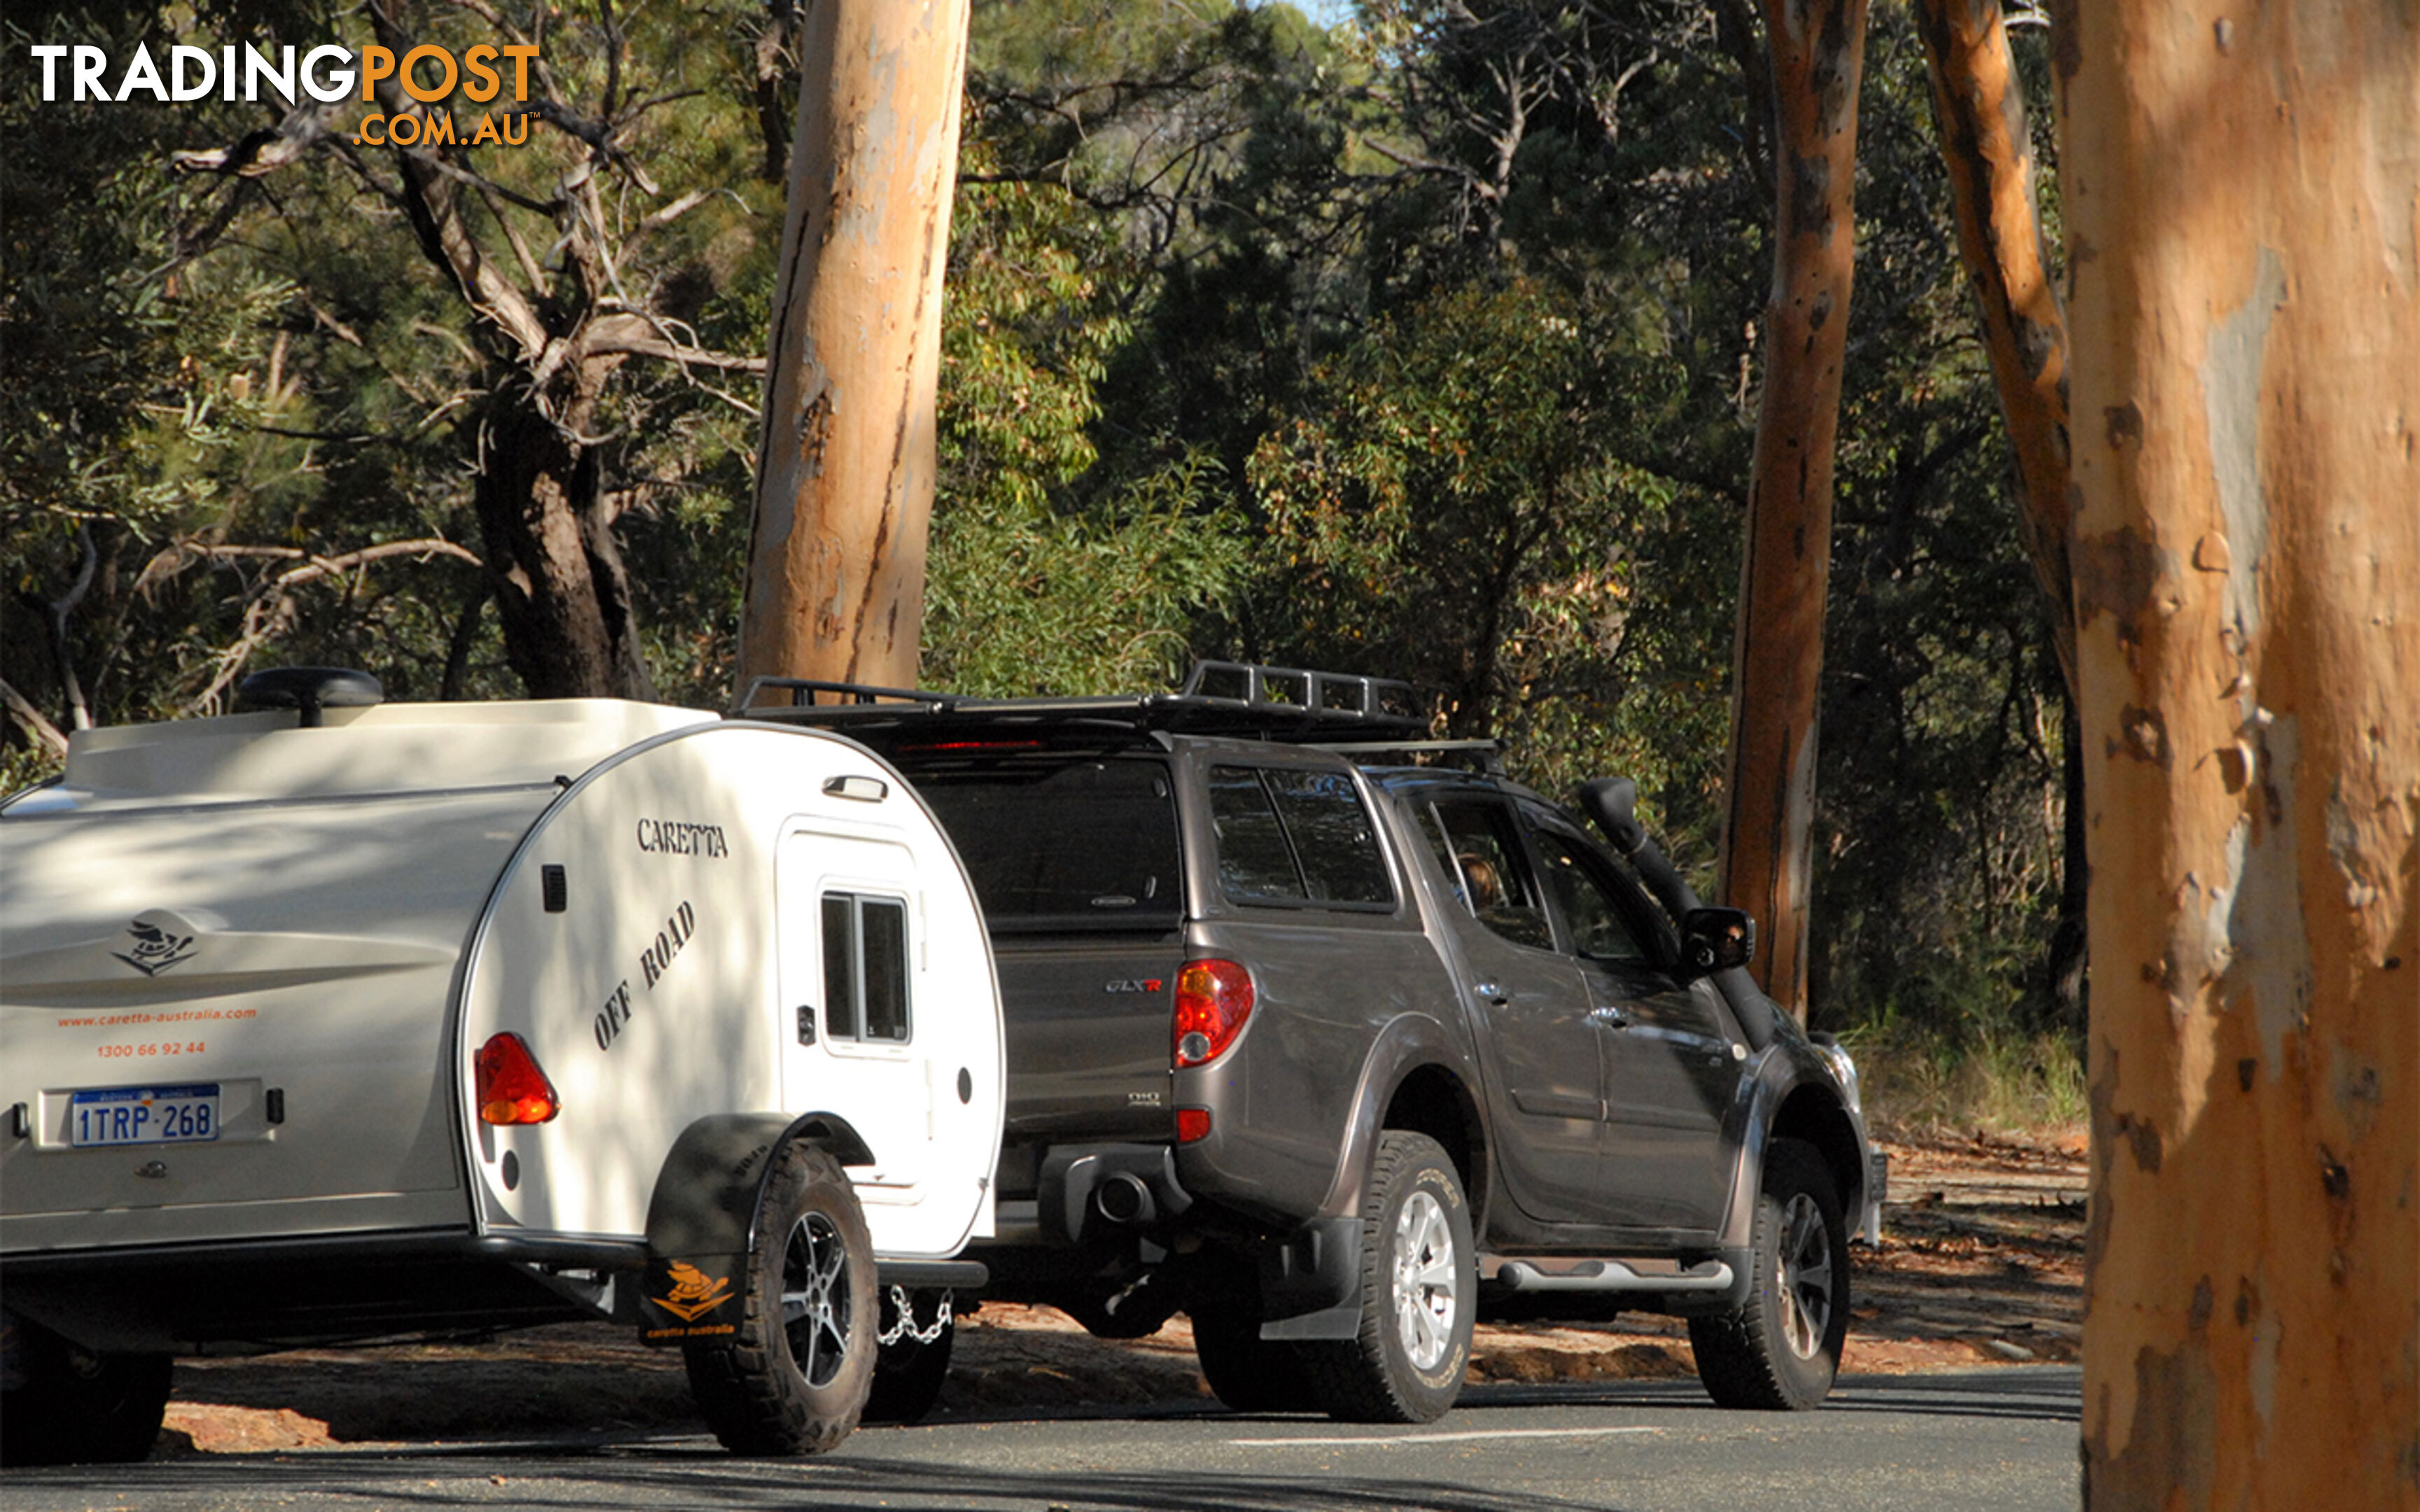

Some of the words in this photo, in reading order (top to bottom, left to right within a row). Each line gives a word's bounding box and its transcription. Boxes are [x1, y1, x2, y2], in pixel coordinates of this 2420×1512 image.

[637, 818, 728, 858] CARETTA
[594, 979, 632, 1051] OFF
[639, 900, 695, 990] ROAD
[58, 1008, 257, 1028] www.caretta-australia.com
[97, 1046, 133, 1058] 1300
[137, 1044, 157, 1056] 66
[162, 1042, 181, 1056] 92
[186, 1041, 206, 1054] 44
